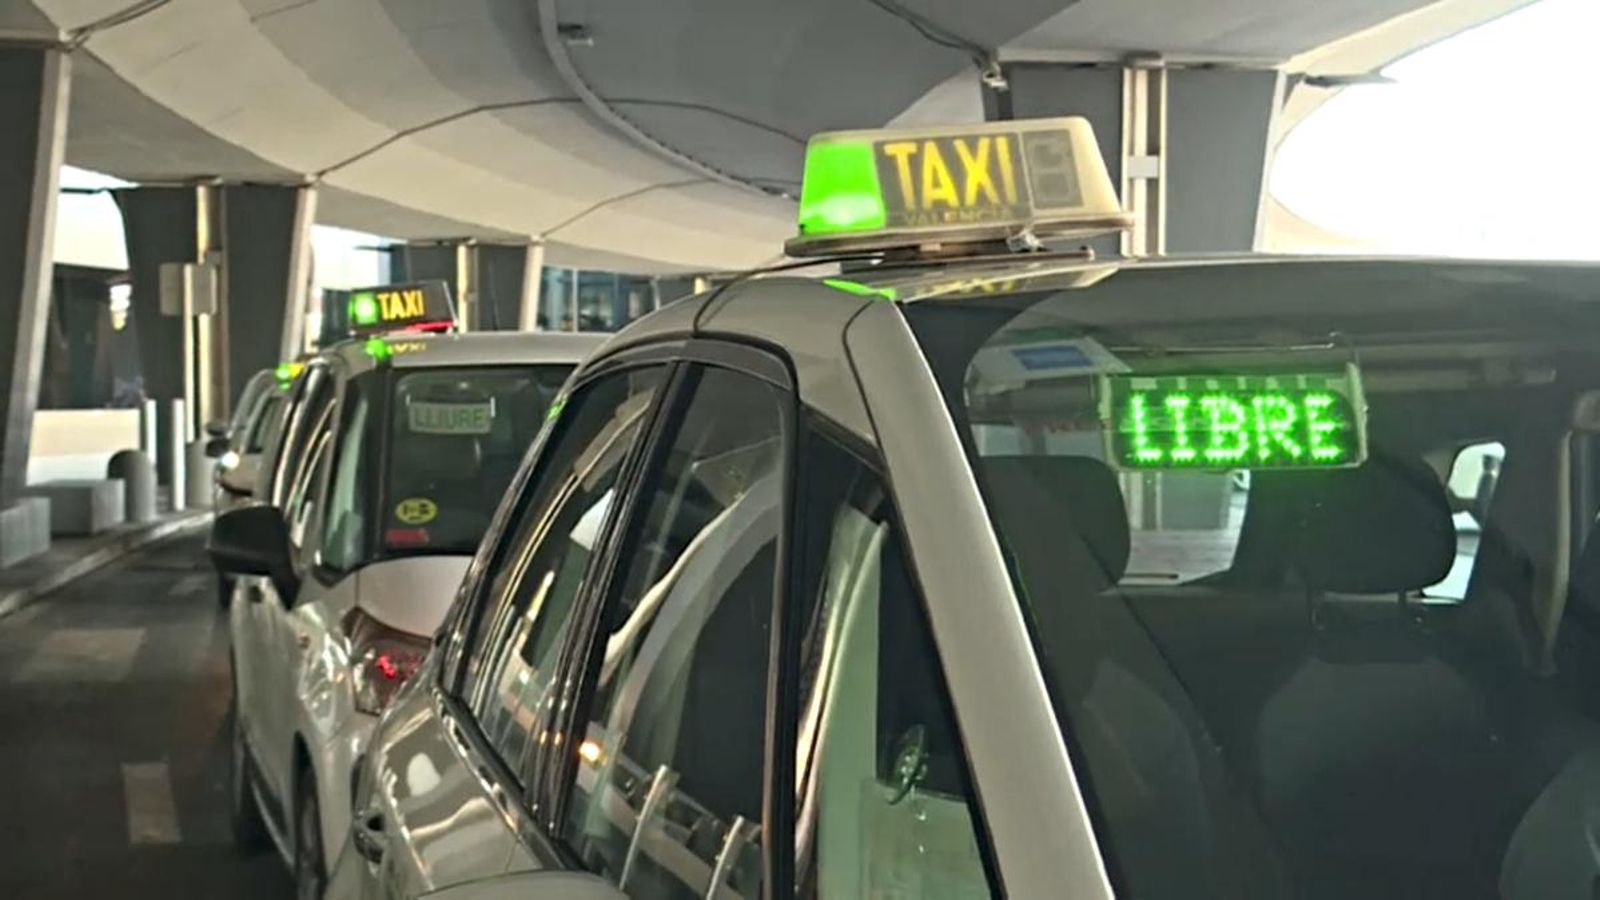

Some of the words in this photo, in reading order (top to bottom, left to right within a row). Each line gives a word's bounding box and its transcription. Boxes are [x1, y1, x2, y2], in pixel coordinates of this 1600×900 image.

[884, 136, 1018, 211] TAXI
[376, 289, 425, 321] TAXI
[413, 405, 487, 431] LLIURE
[1130, 392, 1341, 461] LIBRE
